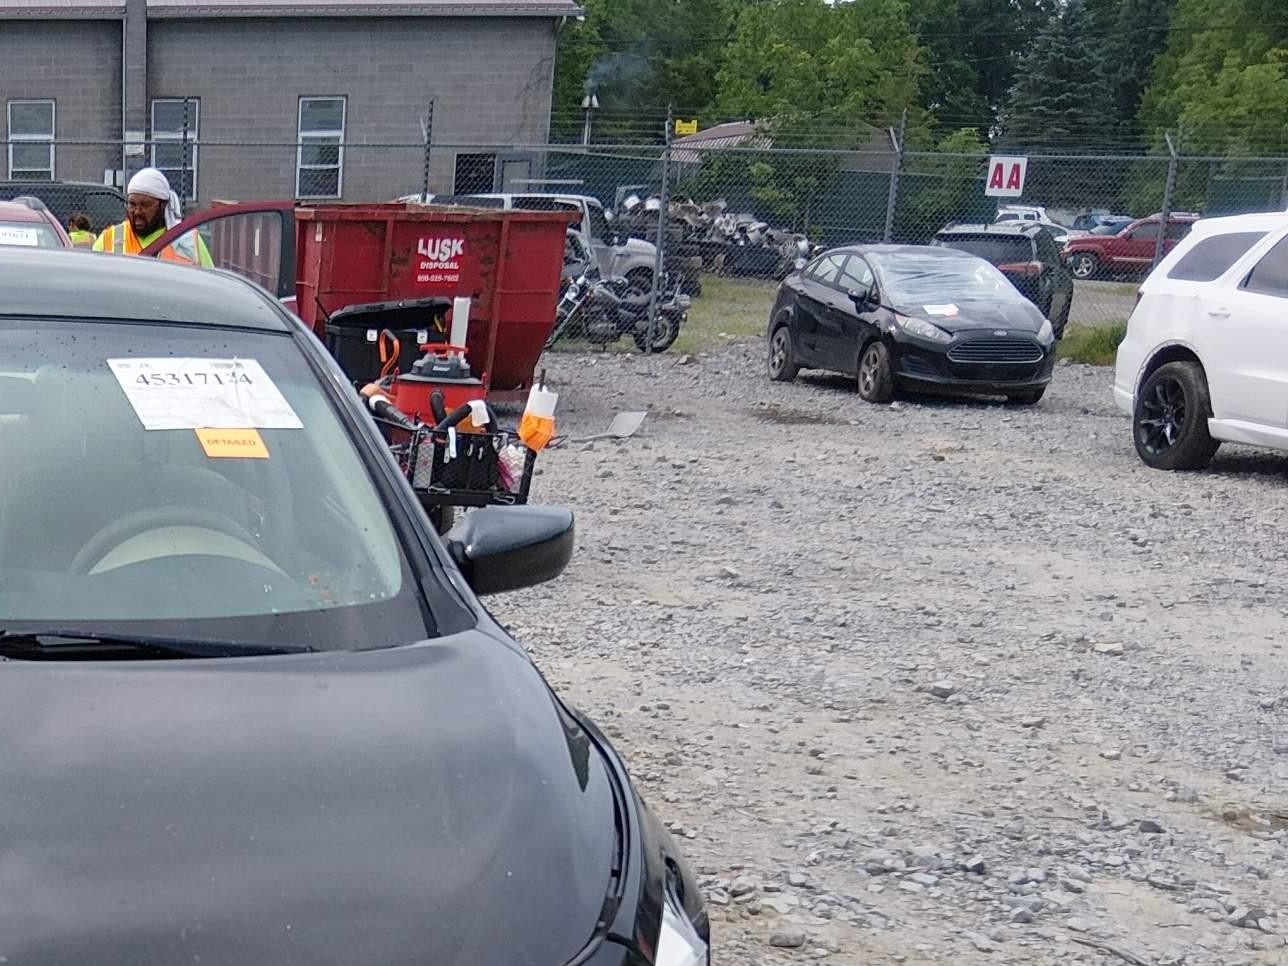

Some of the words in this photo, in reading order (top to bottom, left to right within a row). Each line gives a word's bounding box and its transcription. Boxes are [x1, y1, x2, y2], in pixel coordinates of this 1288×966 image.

[989, 162, 1021, 190] AA
[417, 237, 464, 262] LUSK
[420, 261, 459, 270] DISPOSAL
[135, 372, 253, 386] 45317134
[206, 438, 256, 447] DETAILED
